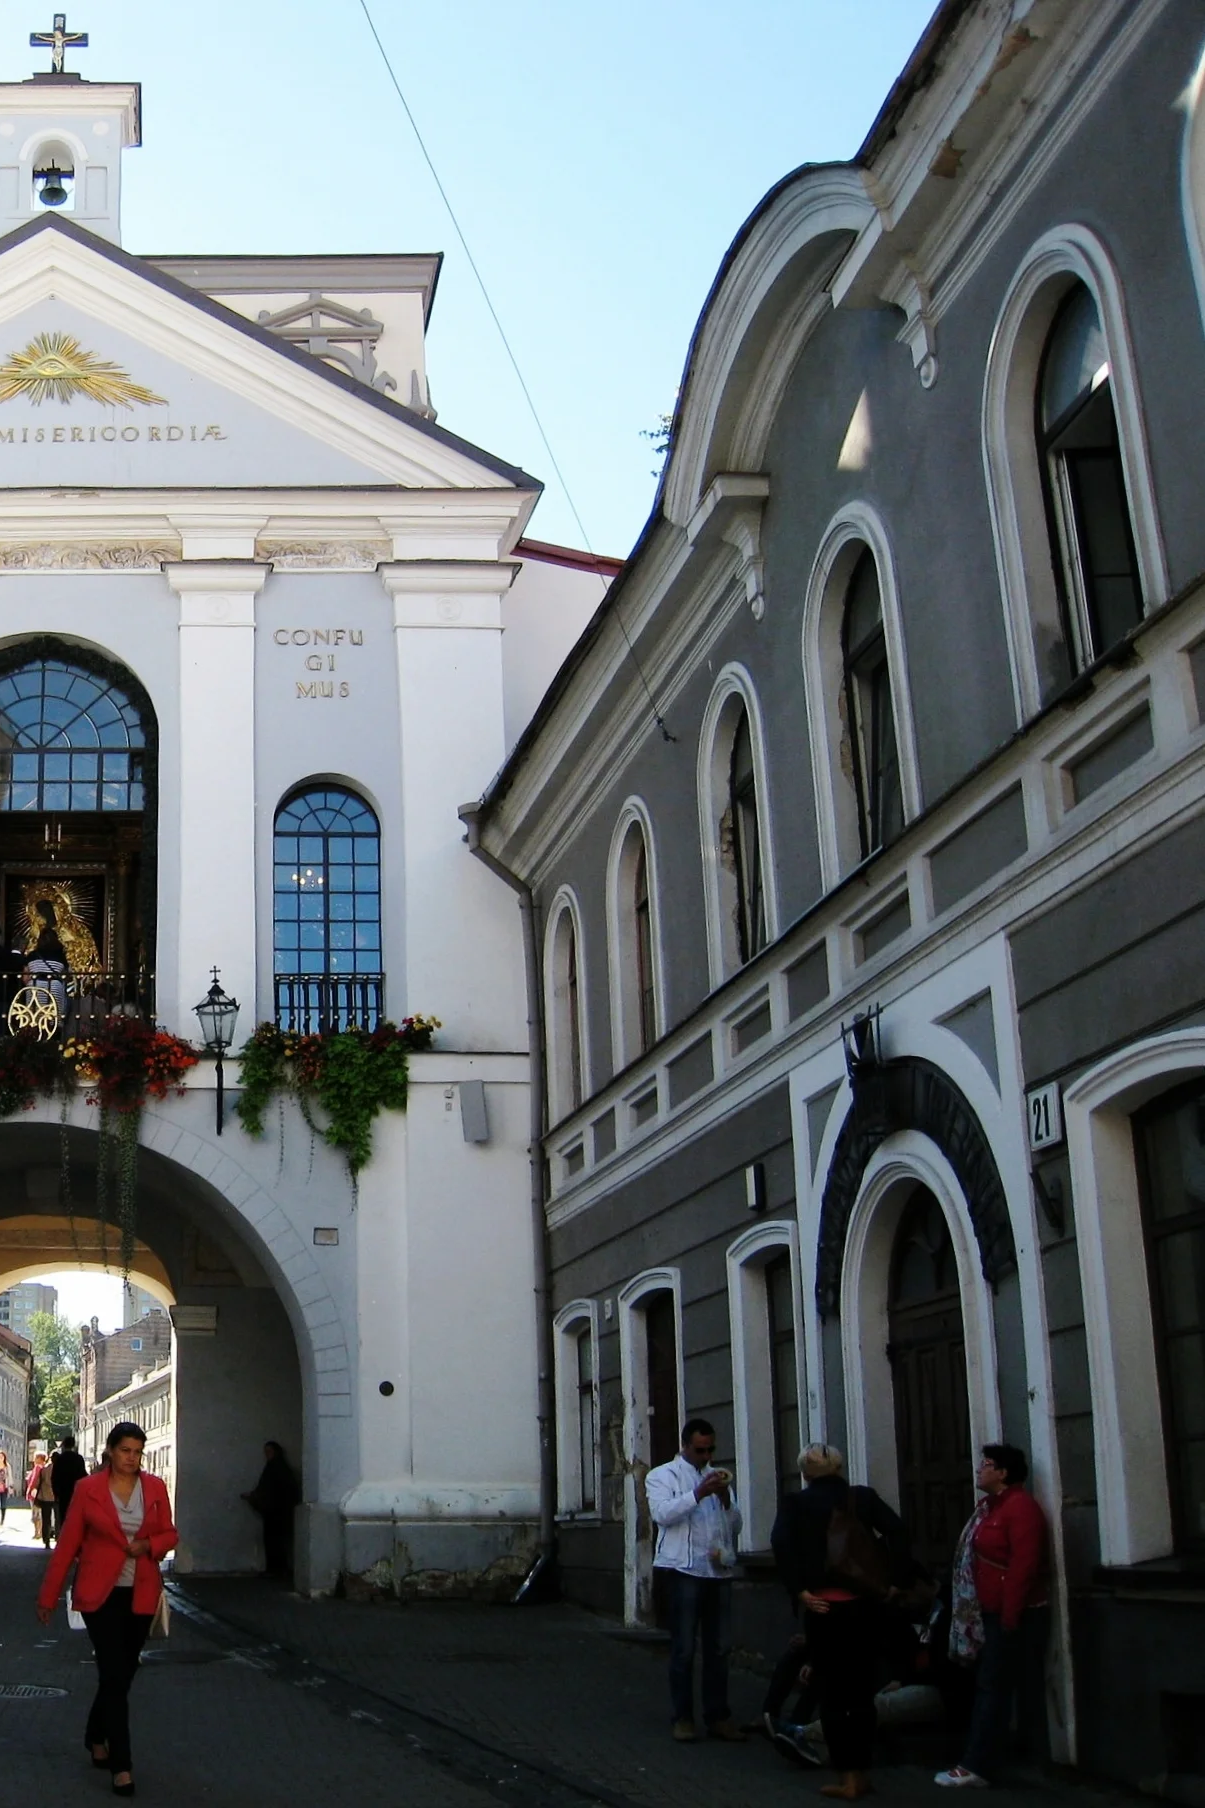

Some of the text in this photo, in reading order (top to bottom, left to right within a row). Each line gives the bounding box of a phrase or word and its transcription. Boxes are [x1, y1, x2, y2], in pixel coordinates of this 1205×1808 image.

[273, 629, 363, 646] CONFU
[296, 681, 349, 699] MUS
[1033, 1094, 1050, 1142] 21
